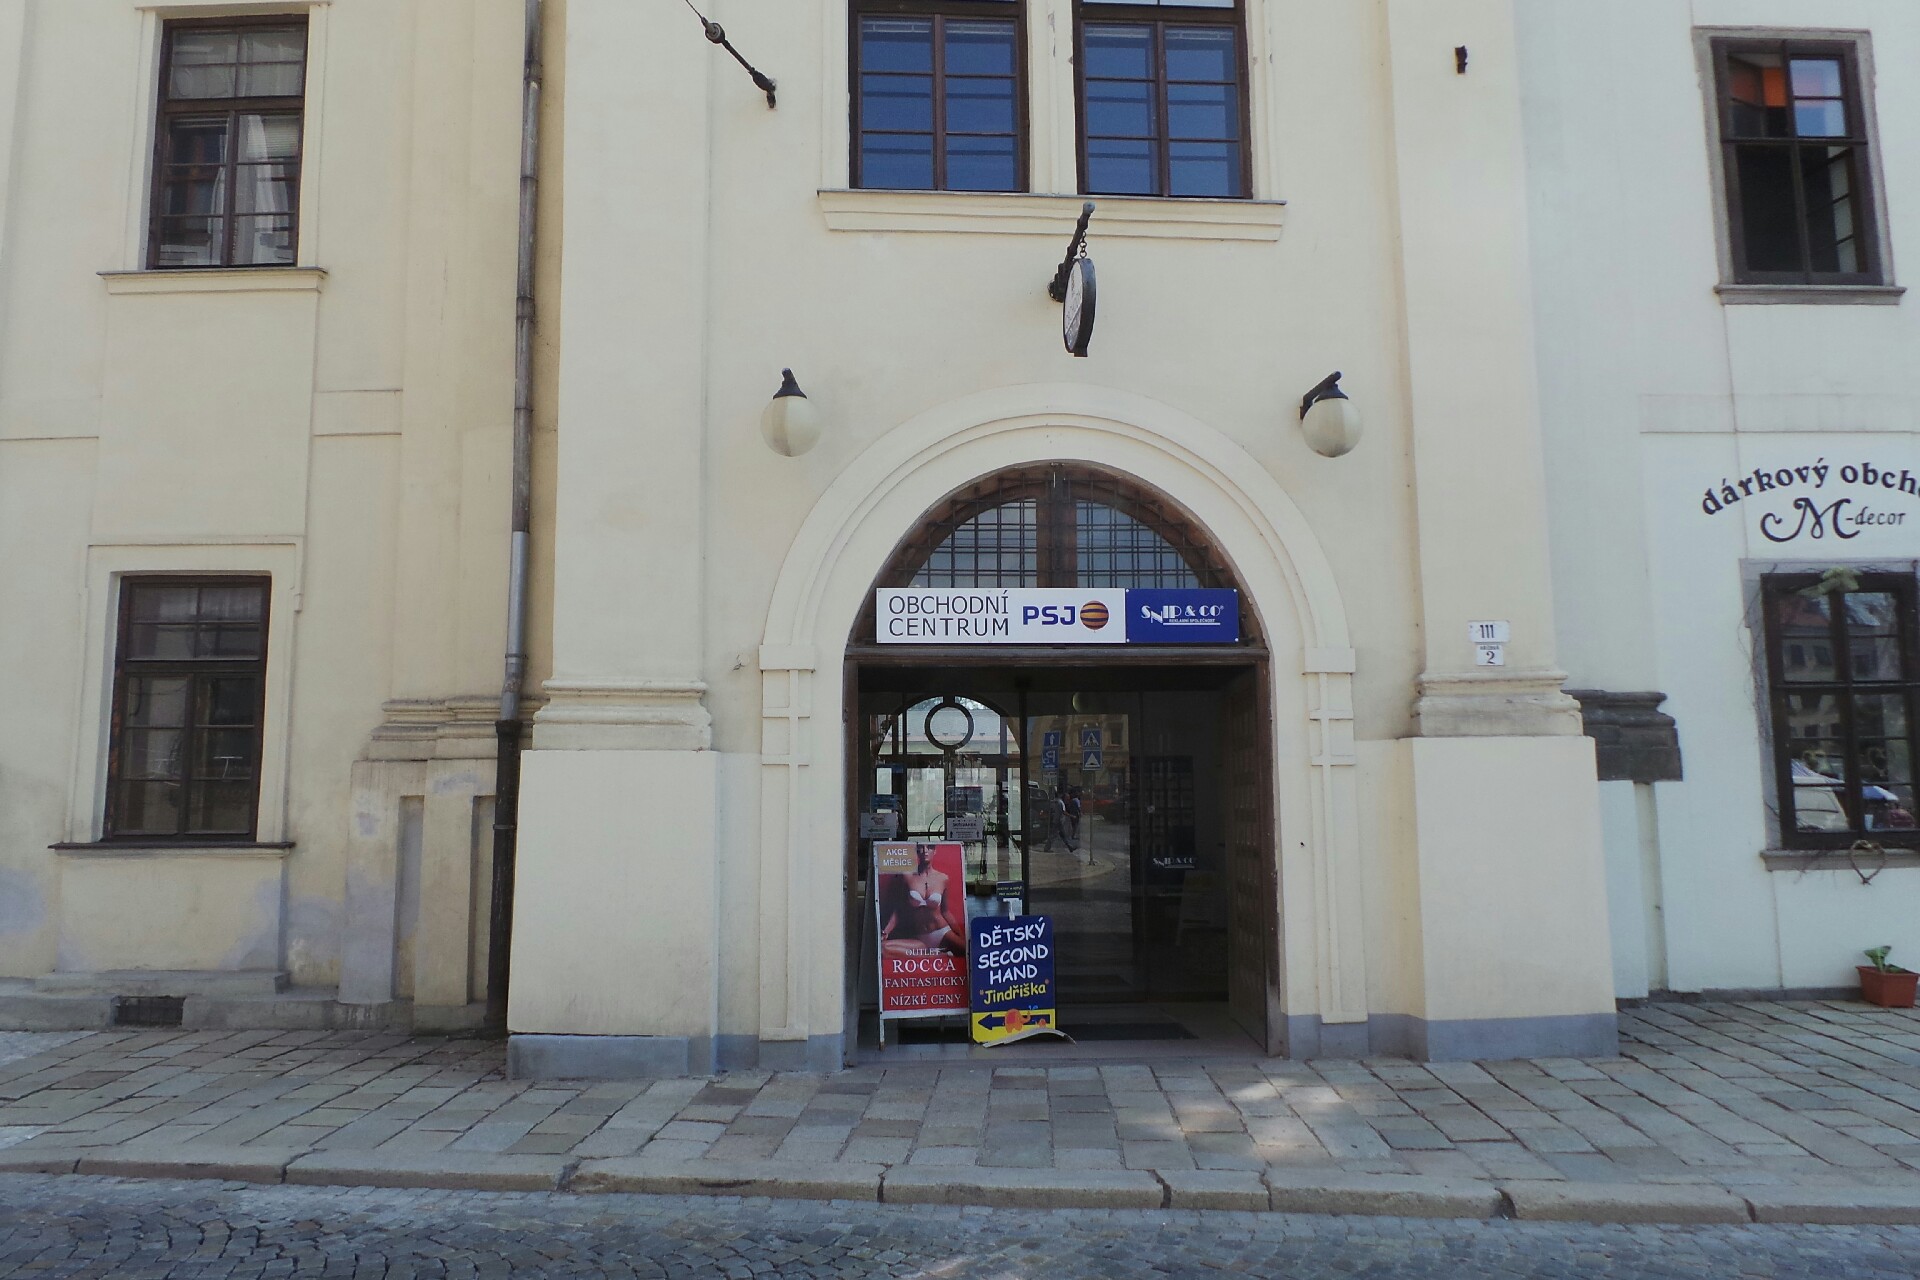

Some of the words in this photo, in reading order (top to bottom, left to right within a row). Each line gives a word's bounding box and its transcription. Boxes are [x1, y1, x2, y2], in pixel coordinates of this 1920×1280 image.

[1701, 457, 1830, 515] dárkový
[1839, 461, 1920, 498] obch
[888, 590, 1010, 615] OBCHODNÍ
[1022, 604, 1077, 626] PSJ
[1141, 605, 1181, 623] SNIP
[1185, 606, 1195, 616] &
[888, 617, 1010, 637] CENTRUM
[1480, 625, 1494, 638] 111
[1486, 651, 1495, 664] 2
[886, 848, 909, 856] AKCE
[883, 857, 913, 866] MĚSÍCE
[980, 917, 1046, 948] DĚTSKÝ
[892, 958, 957, 974] ROCCA
[978, 945, 1048, 969] SECOND
[884, 976, 967, 988] FANTASTICKY
[989, 965, 1038, 985] HAND
[889, 993, 928, 1006] NÍZKÉ
[930, 994, 962, 1004] CENY
